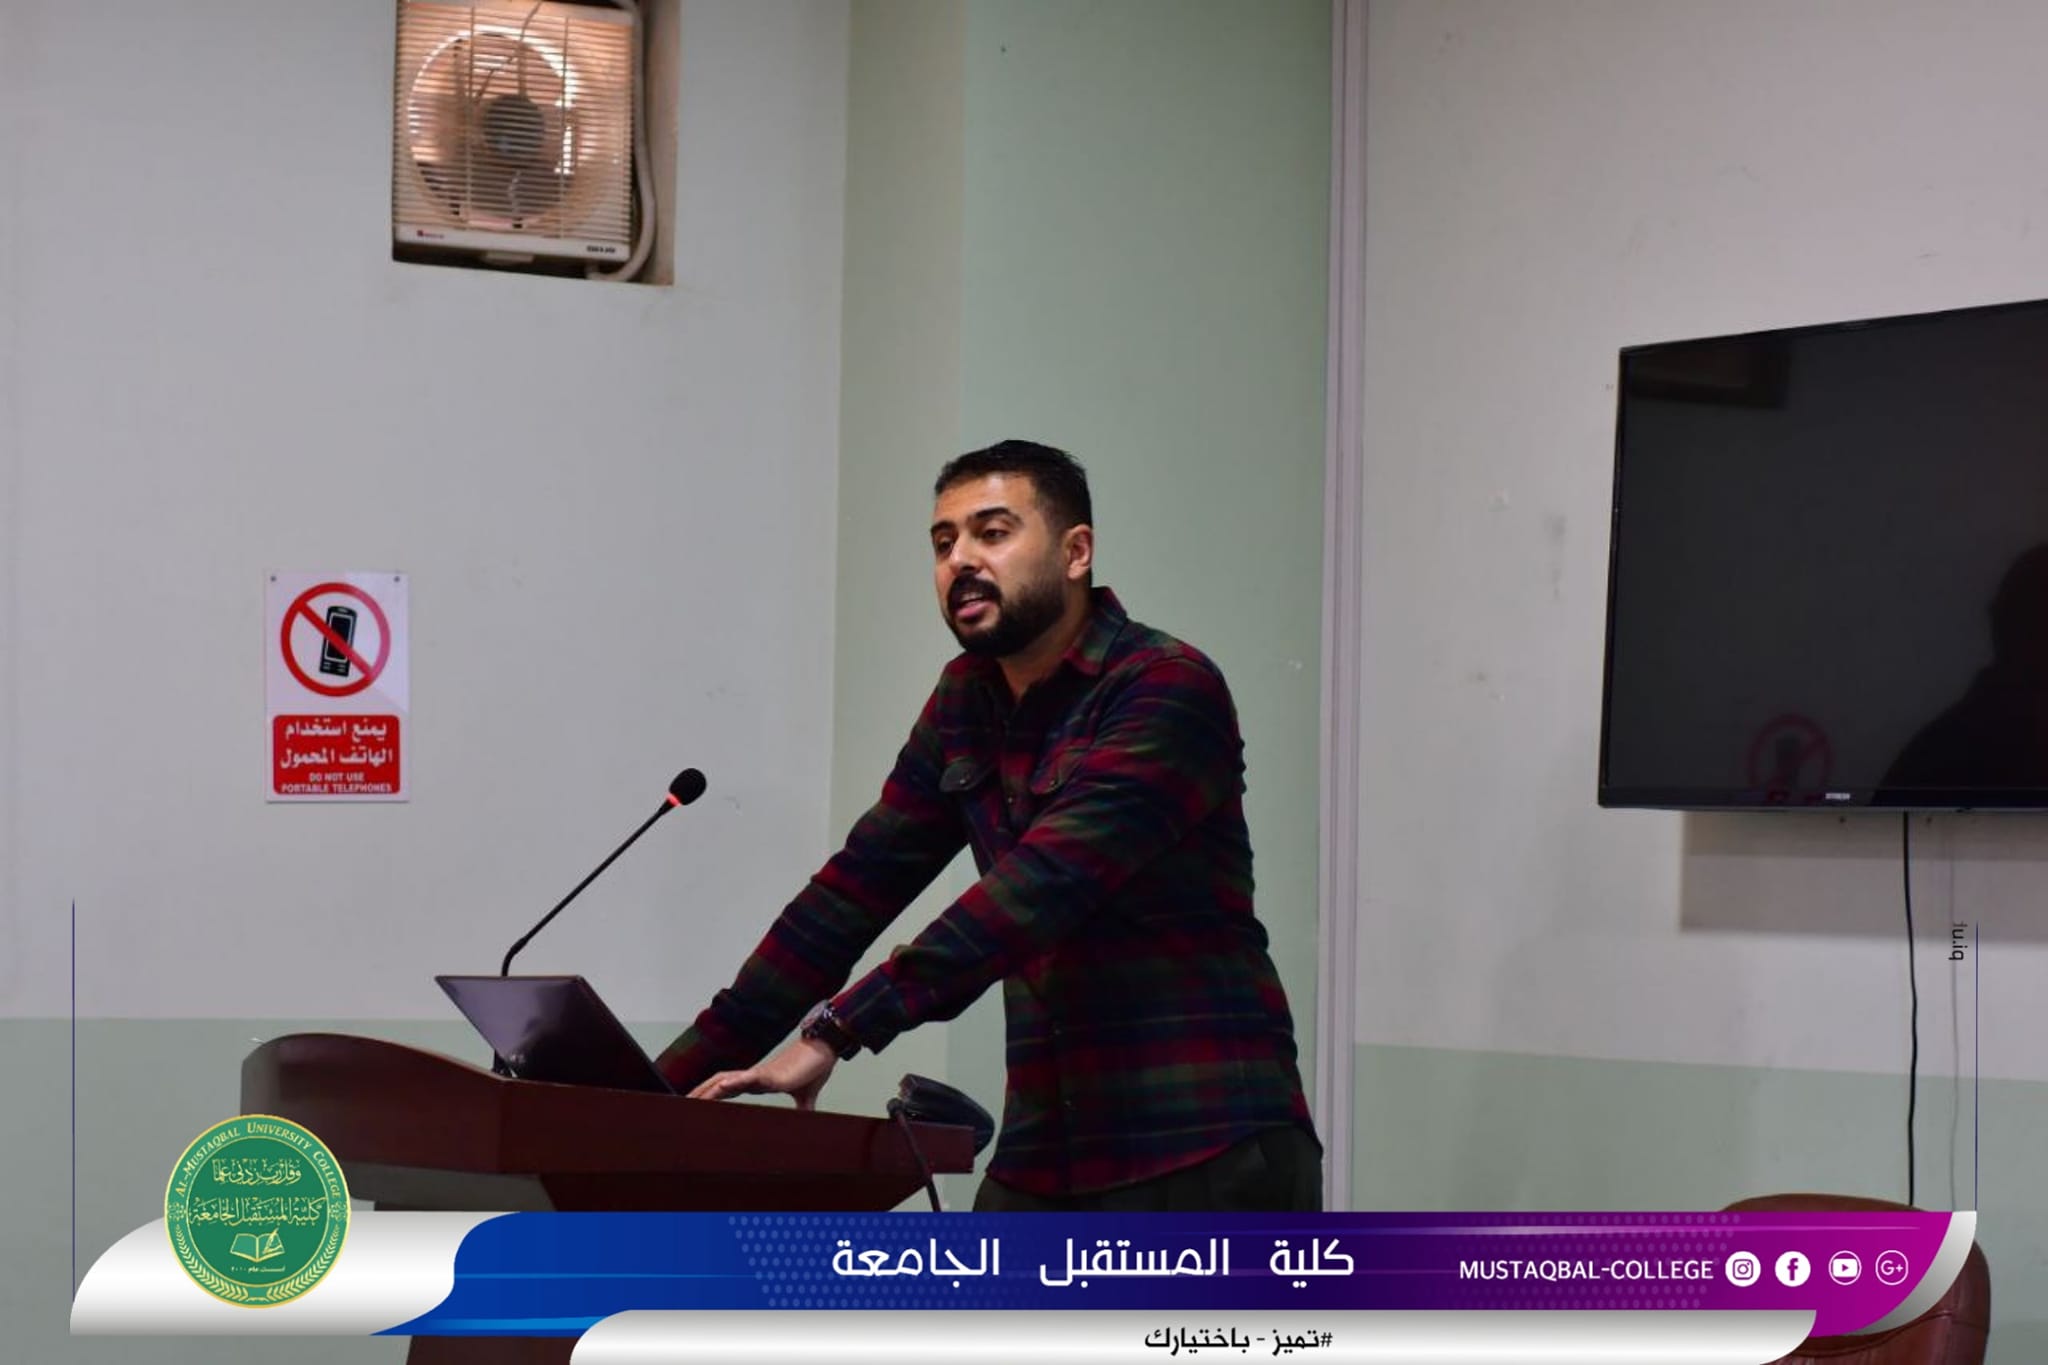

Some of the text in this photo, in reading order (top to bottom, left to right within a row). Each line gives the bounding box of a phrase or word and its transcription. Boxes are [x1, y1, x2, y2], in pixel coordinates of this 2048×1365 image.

[285, 717, 387, 742] يمنع استخدام
[280, 745, 393, 769] الهاتف المحمول
[309, 772, 365, 782] DO NOT USE
[281, 783, 392, 793] PORTABLE TELEPHONES
